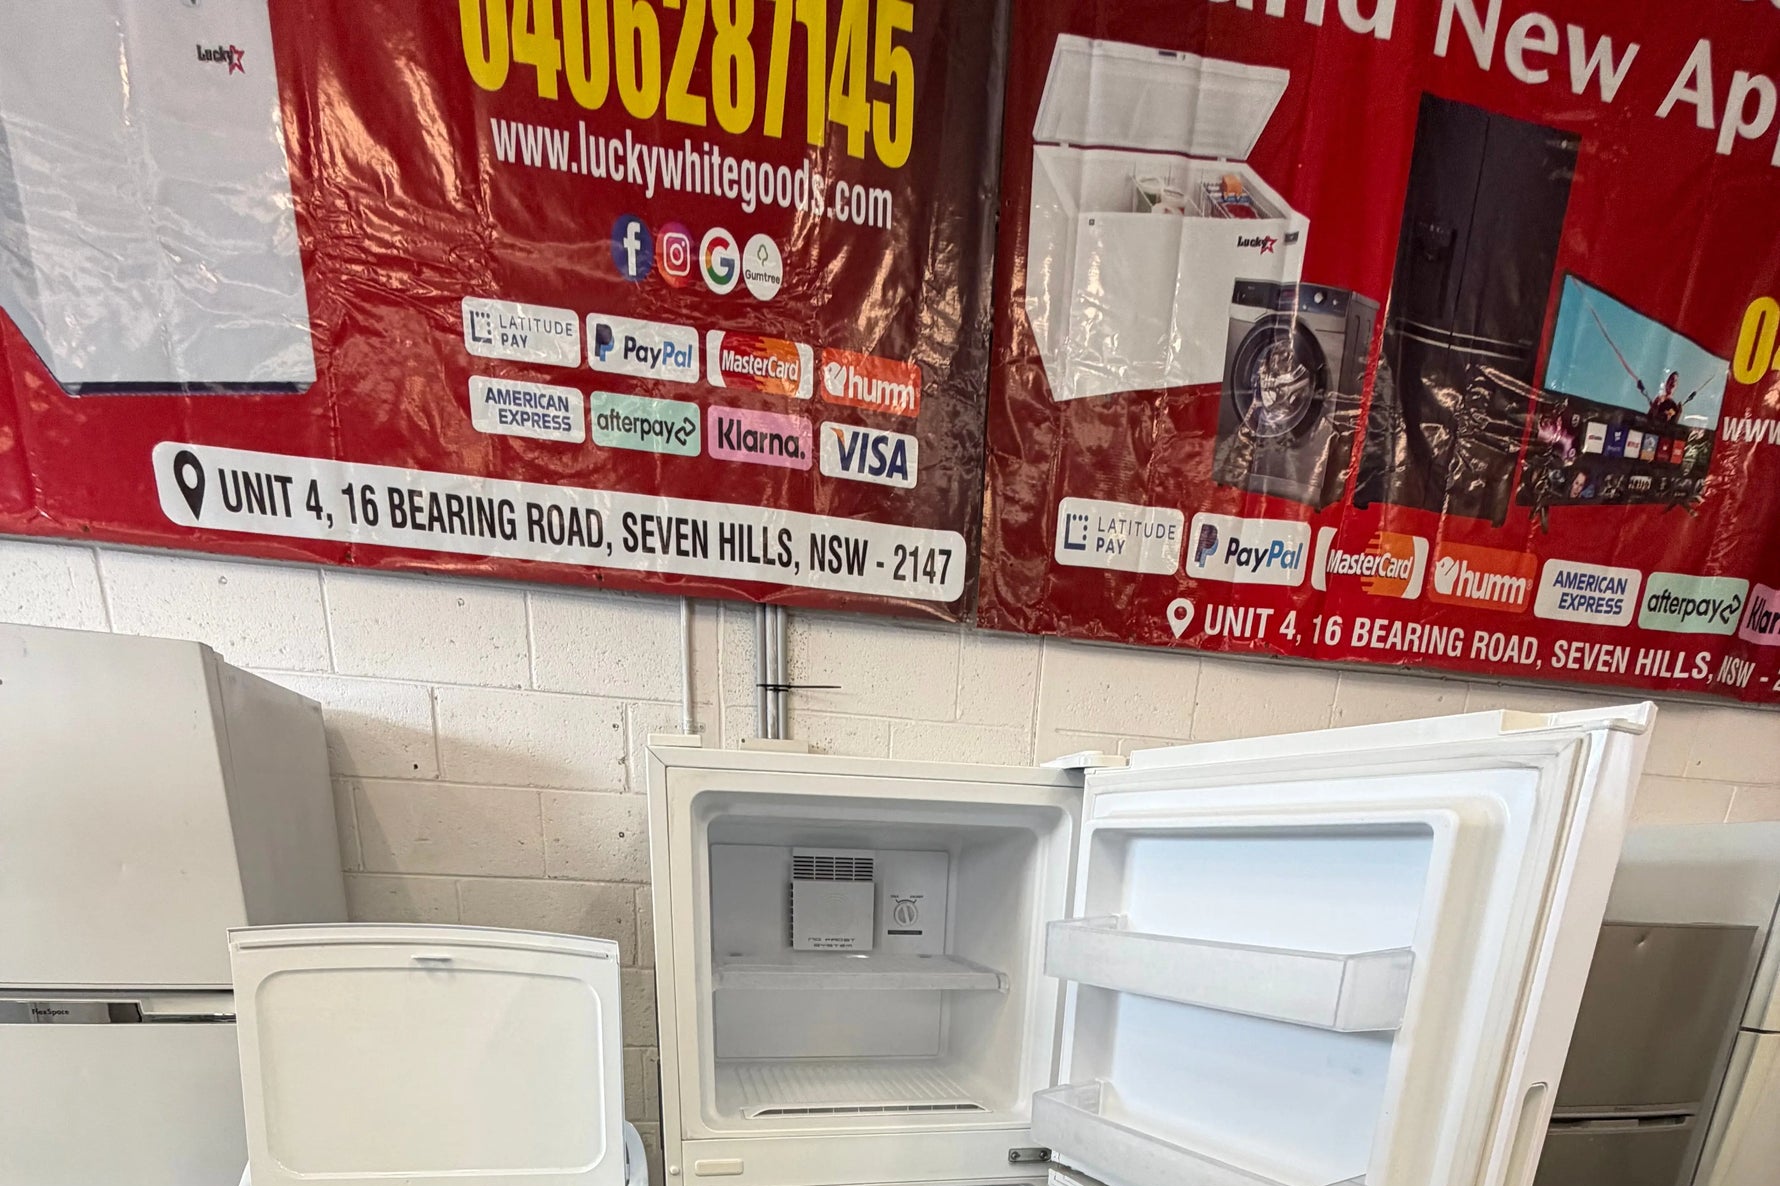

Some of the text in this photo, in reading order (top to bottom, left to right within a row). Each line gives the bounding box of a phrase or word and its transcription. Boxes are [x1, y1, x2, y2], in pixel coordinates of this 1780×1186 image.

[196, 44, 234, 66] Lucky
[1433, 0, 1780, 167] New Ap
[490, 117, 893, 230] www.luckywhitegoods.com
[1237, 235, 1268, 249] Lucky
[744, 269, 781, 285] Gumtree
[498, 314, 573, 337] LATITUDE
[500, 332, 528, 349] PAY
[1733, 296, 1780, 385] 0
[623, 335, 693, 369] PayPal
[721, 349, 799, 381] MasterCard
[484, 386, 570, 413] AMERICAN
[849, 366, 915, 410] humm
[498, 408, 572, 433] EXPRESS
[596, 408, 676, 444] afterpay
[717, 416, 806, 460] Klarna.
[829, 426, 909, 481] VISA
[218, 467, 293, 518] UNIT
[305, 478, 333, 529] 4,
[341, 482, 380, 527] 16
[387, 485, 518, 541] BEARING
[528, 502, 613, 557] ROAD,
[622, 511, 709, 559] SEVEN
[718, 521, 800, 576] HILLS,
[809, 532, 869, 577] NSW
[892, 543, 952, 585] 2147
[1097, 516, 1177, 540] LATITUDE
[1096, 536, 1125, 555] PAY
[1224, 536, 1304, 573] PayPal
[1326, 548, 1414, 580] MasterCard
[1552, 569, 1629, 596] AMERICAN
[1558, 592, 1624, 616] EXPRESS
[1647, 588, 1724, 624] afterpay
[1746, 595, 1780, 635] Klar
[1203, 603, 1274, 639] UNIT
[1279, 610, 1302, 645] 4,
[1312, 614, 1343, 646] 16
[1351, 616, 1463, 653] BEARING
[1470, 631, 1542, 670] ROAD,
[1551, 640, 1631, 674] SEVEN
[1634, 648, 1714, 684] HILLS,
[1716, 655, 1756, 688] NSW
